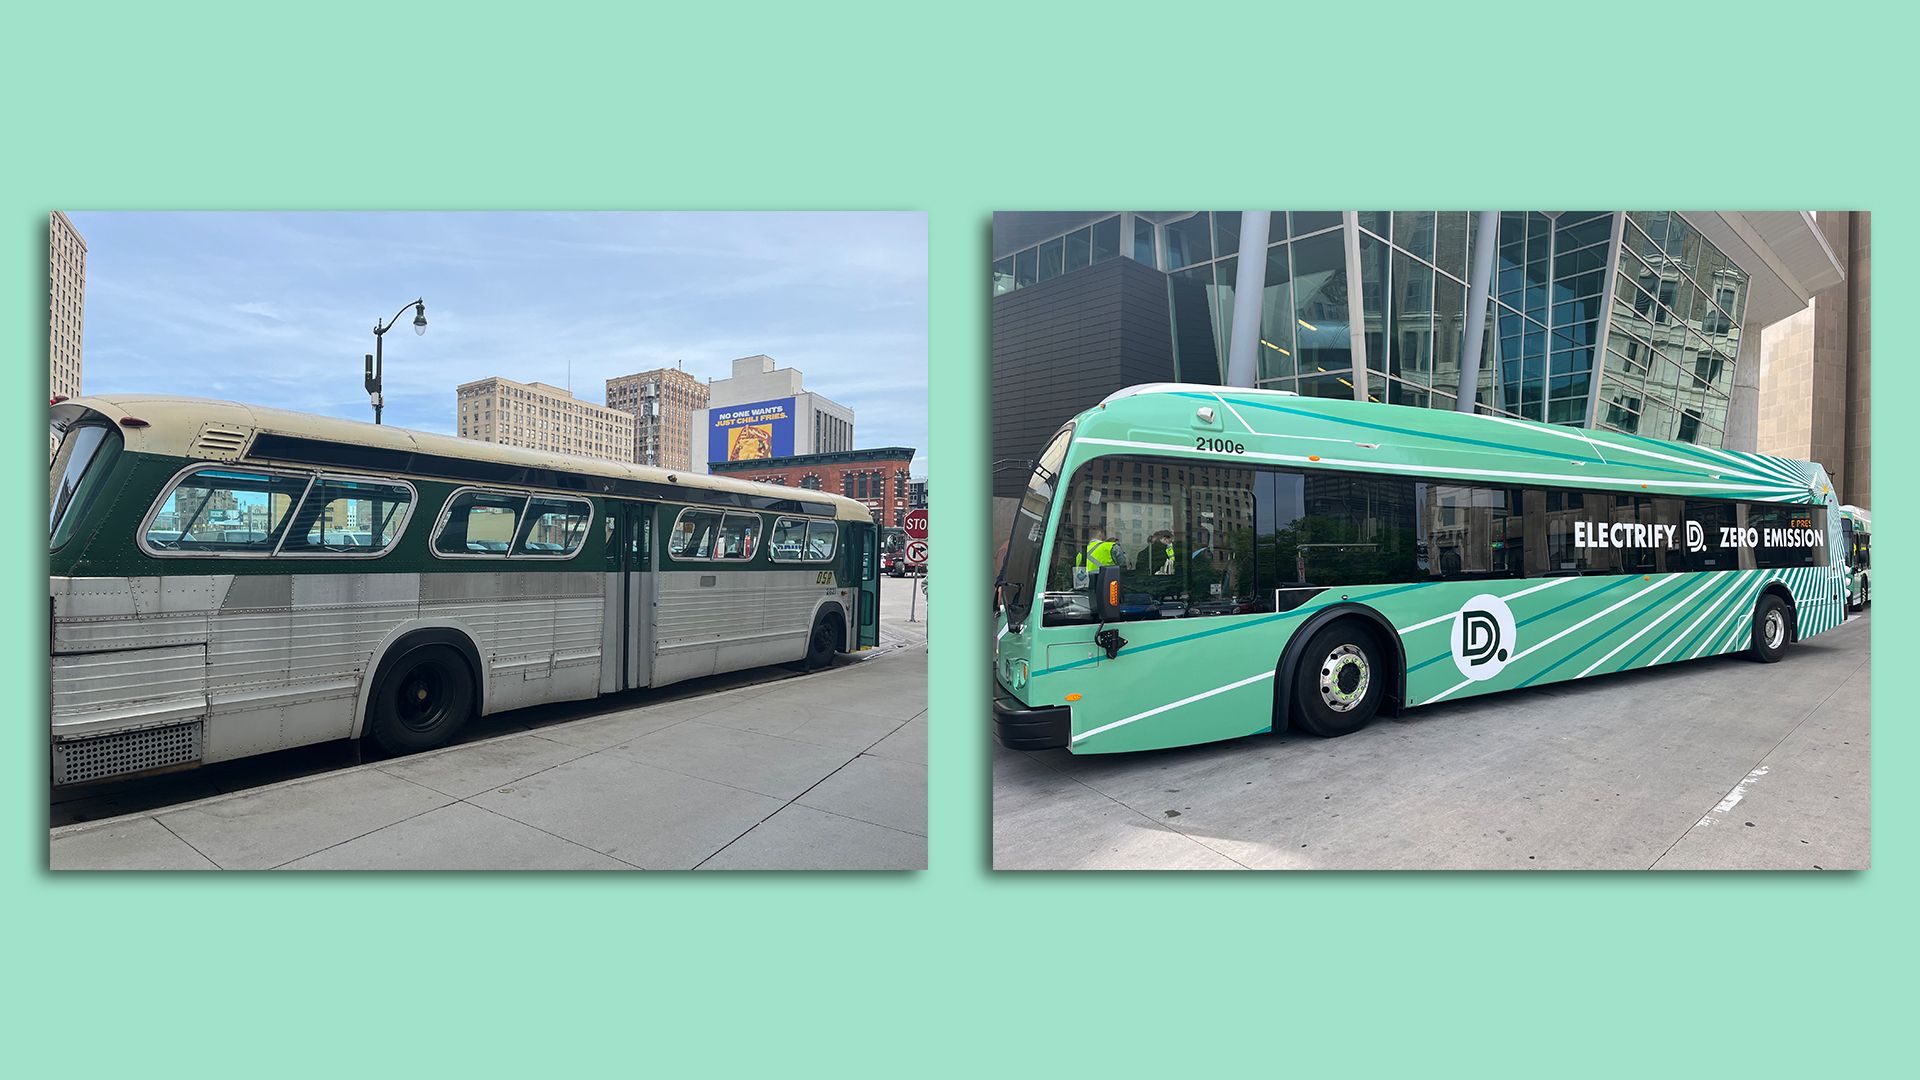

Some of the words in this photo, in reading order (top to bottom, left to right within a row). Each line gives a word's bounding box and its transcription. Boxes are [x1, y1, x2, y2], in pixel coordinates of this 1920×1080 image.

[715, 418, 735, 427] JUST
[736, 415, 759, 424] CHILI
[760, 412, 788, 421] FRIES.
[732, 410, 750, 418] ONE
[751, 405, 783, 415] WANTS
[1196, 436, 1245, 454] 2100e
[1574, 521, 1677, 548] ELECTRIFY
[1719, 527, 1759, 549] ZERO
[1763, 528, 1824, 548] EMISSION
